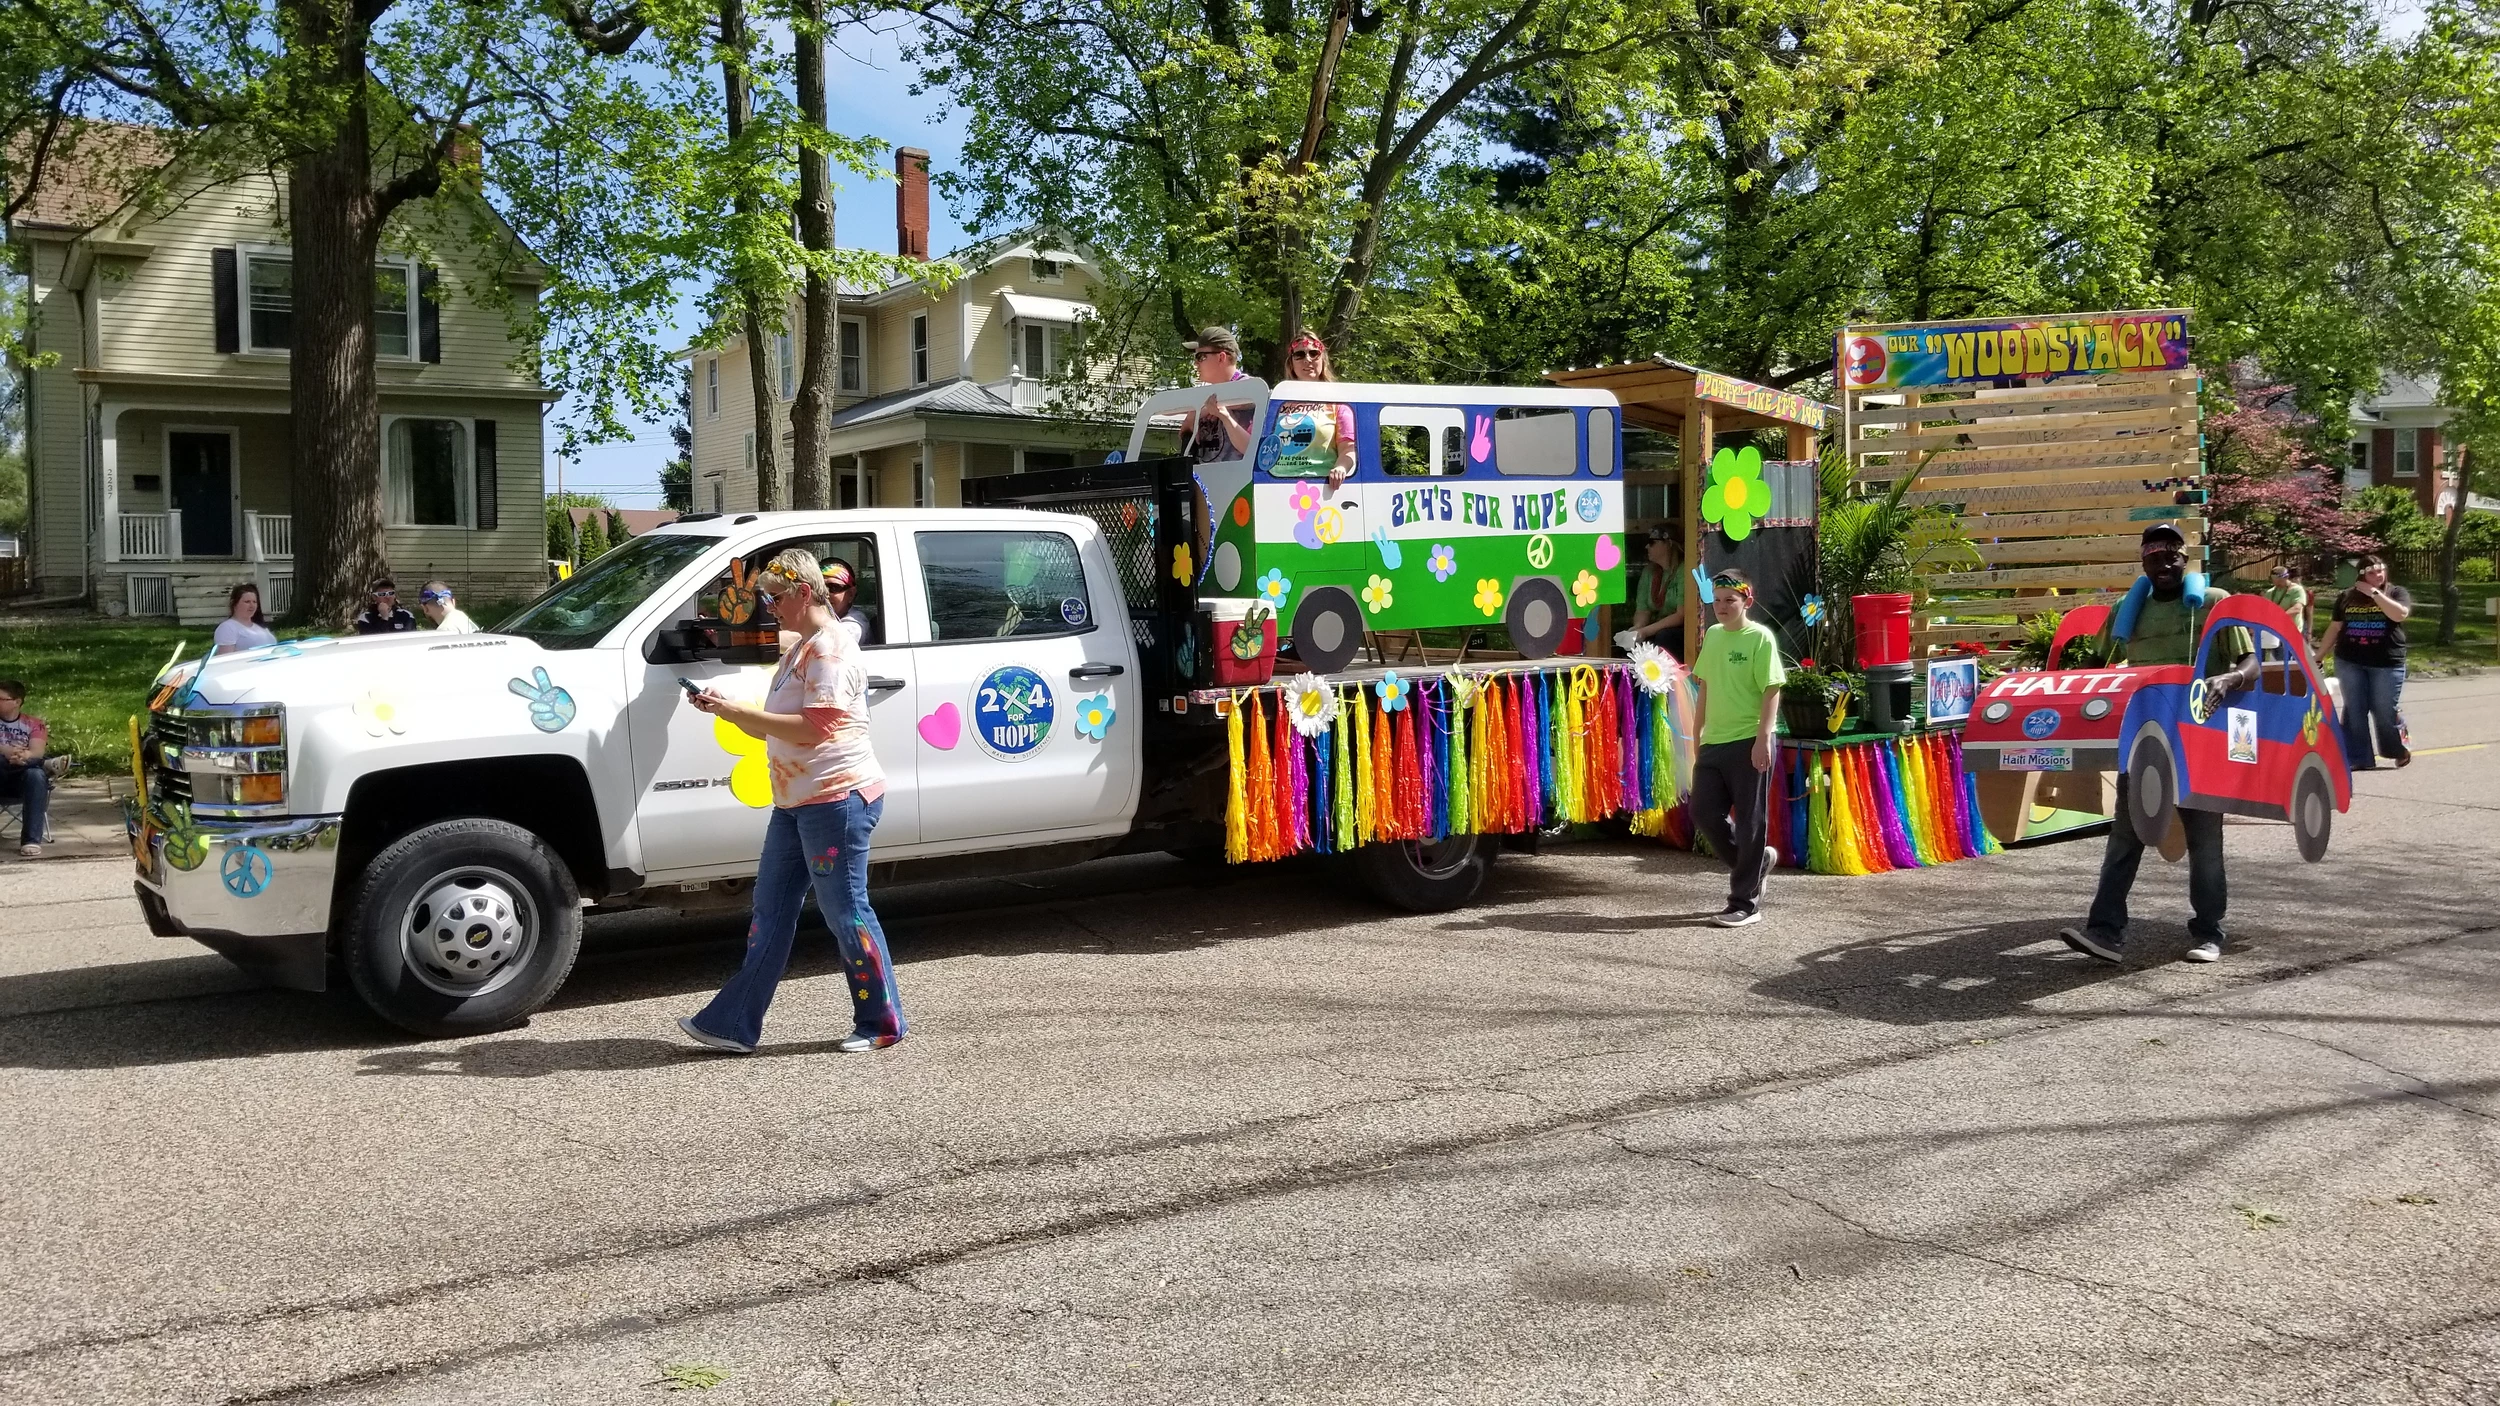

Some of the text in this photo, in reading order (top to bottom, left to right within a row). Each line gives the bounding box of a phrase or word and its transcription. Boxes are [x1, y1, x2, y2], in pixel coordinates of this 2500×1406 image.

[1888, 335, 1919, 352] OUR
[1697, 373, 1824, 426] "POTTY" LIKE IT'S 1969
[1391, 484, 1568, 531] 2X4'S FOR HOPE
[1989, 674, 2137, 697] HAITI
[1007, 713, 1024, 722] FOR
[992, 750, 1006, 759] MAKE
[1022, 735, 1051, 758] DIFFERENCE
[993, 723, 1038, 748] HOPE
[2002, 754, 2071, 767] Haiti Missions
